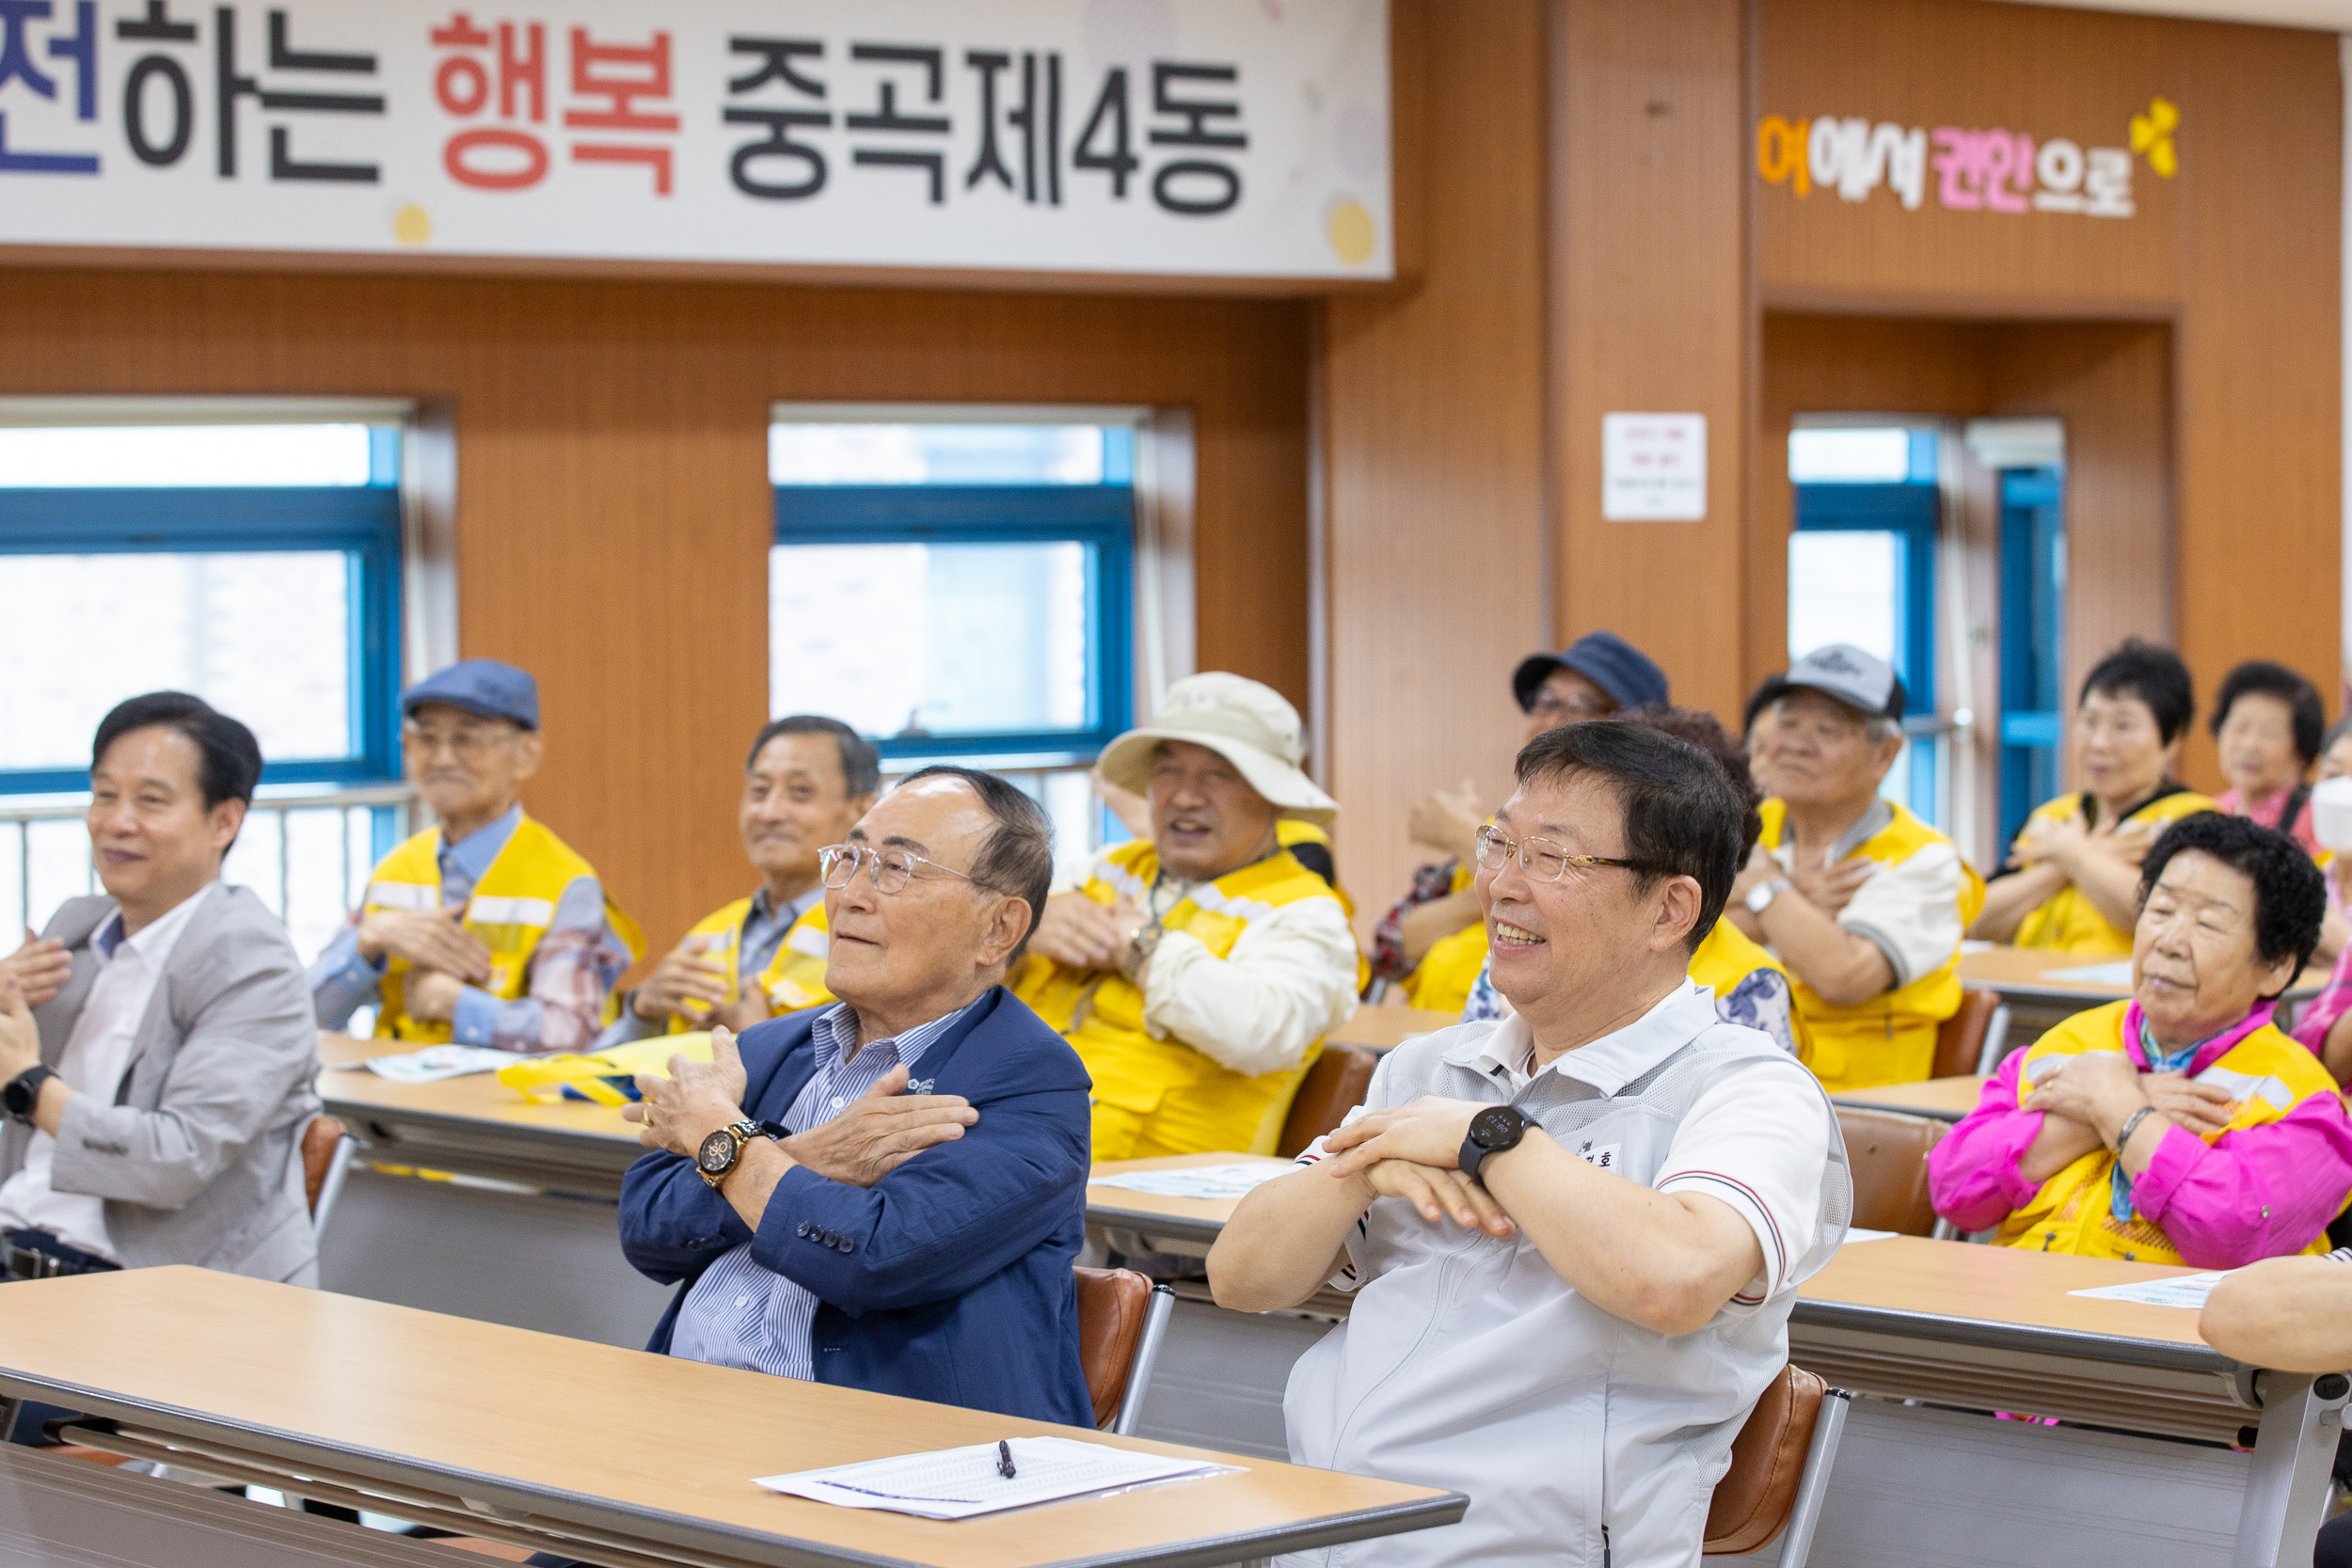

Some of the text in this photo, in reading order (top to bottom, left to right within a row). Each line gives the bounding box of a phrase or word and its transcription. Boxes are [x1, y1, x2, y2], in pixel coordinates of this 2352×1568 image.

[0, 0, 1249, 216] 전하는 행복 중곡제4동
